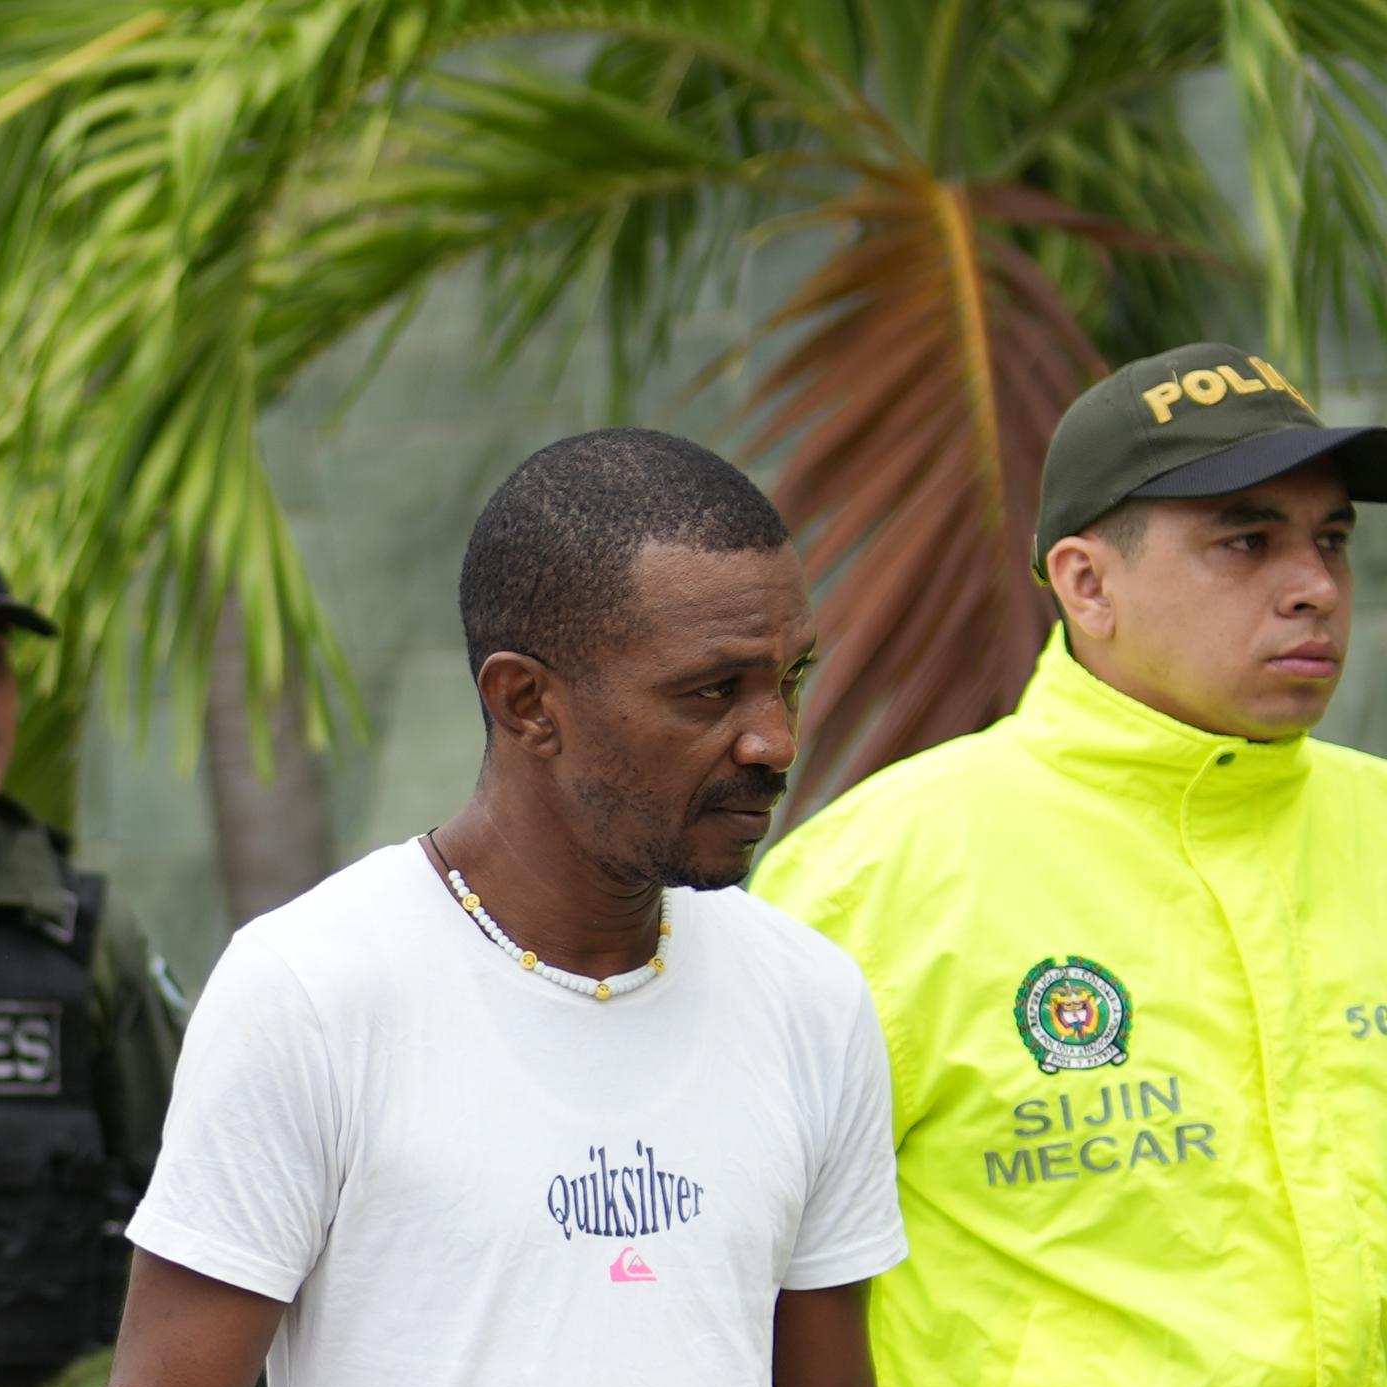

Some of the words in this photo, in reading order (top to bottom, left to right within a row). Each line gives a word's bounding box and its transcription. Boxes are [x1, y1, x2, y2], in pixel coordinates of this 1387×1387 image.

[1142, 356, 1316, 424] POLI
[1014, 1076, 1181, 1138] SIJIN
[984, 1123, 1217, 1186] MECAR
[547, 1139, 705, 1241] Quiksilver
